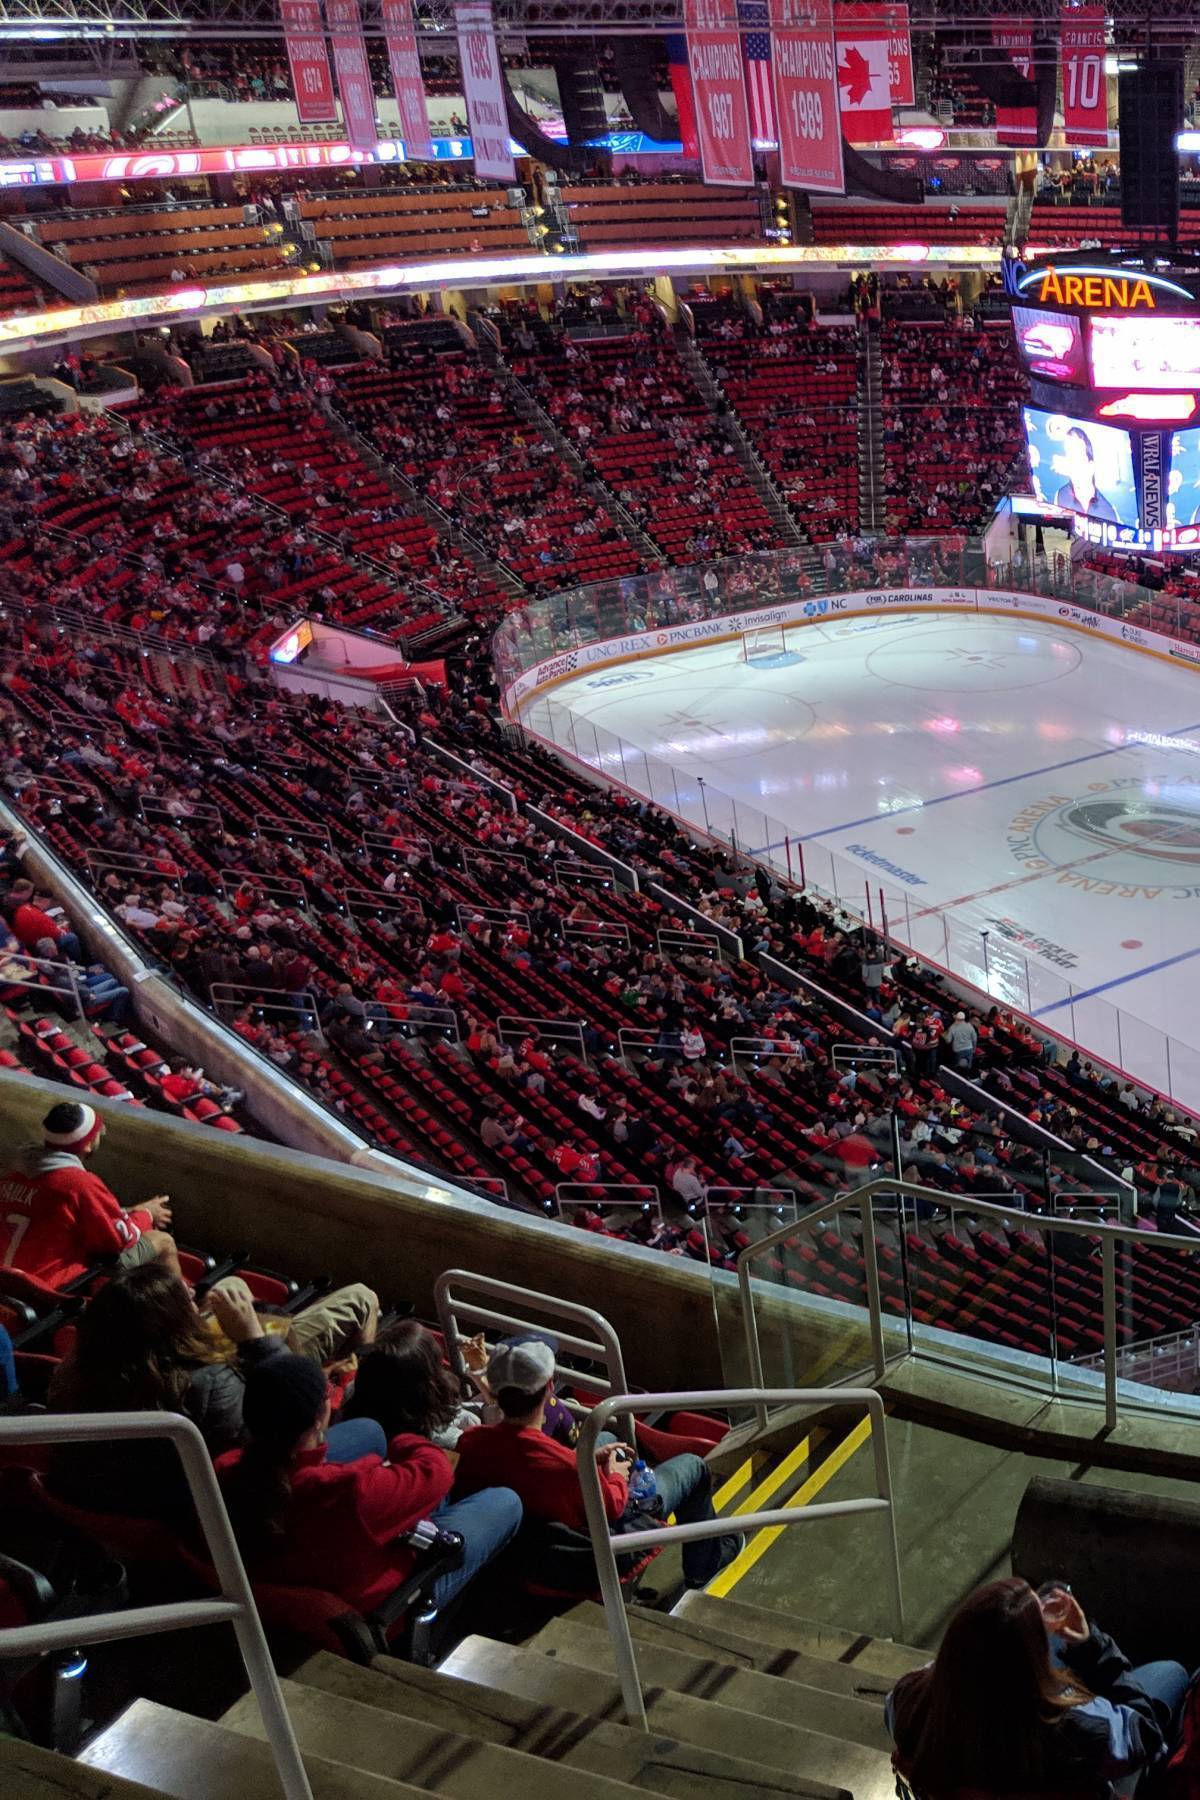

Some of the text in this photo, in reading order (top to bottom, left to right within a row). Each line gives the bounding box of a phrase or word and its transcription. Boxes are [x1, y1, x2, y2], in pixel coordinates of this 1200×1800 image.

[466, 32, 493, 80] 1983
[1066, 32, 1102, 46] FRANCIS
[691, 43, 741, 81] CHAMPIONS
[775, 39, 834, 81] CHAMPIONS
[1068, 54, 1100, 109] 10
[708, 93, 735, 140] 1987
[792, 90, 824, 141] 1989
[1040, 265, 1156, 308] ARENA
[1143, 434, 1160, 527] WRAL NEWS
[831, 598, 848, 611] NC
[888, 593, 934, 603] CAROLINAS
[538, 656, 567, 676] Advance
[586, 636, 652, 662] UNC REX
[587, 672, 640, 690] Spirit
[1007, 794, 1072, 834] ARENA
[845, 843, 928, 887] ticketmaster
[1006, 834, 1041, 862] PNC
